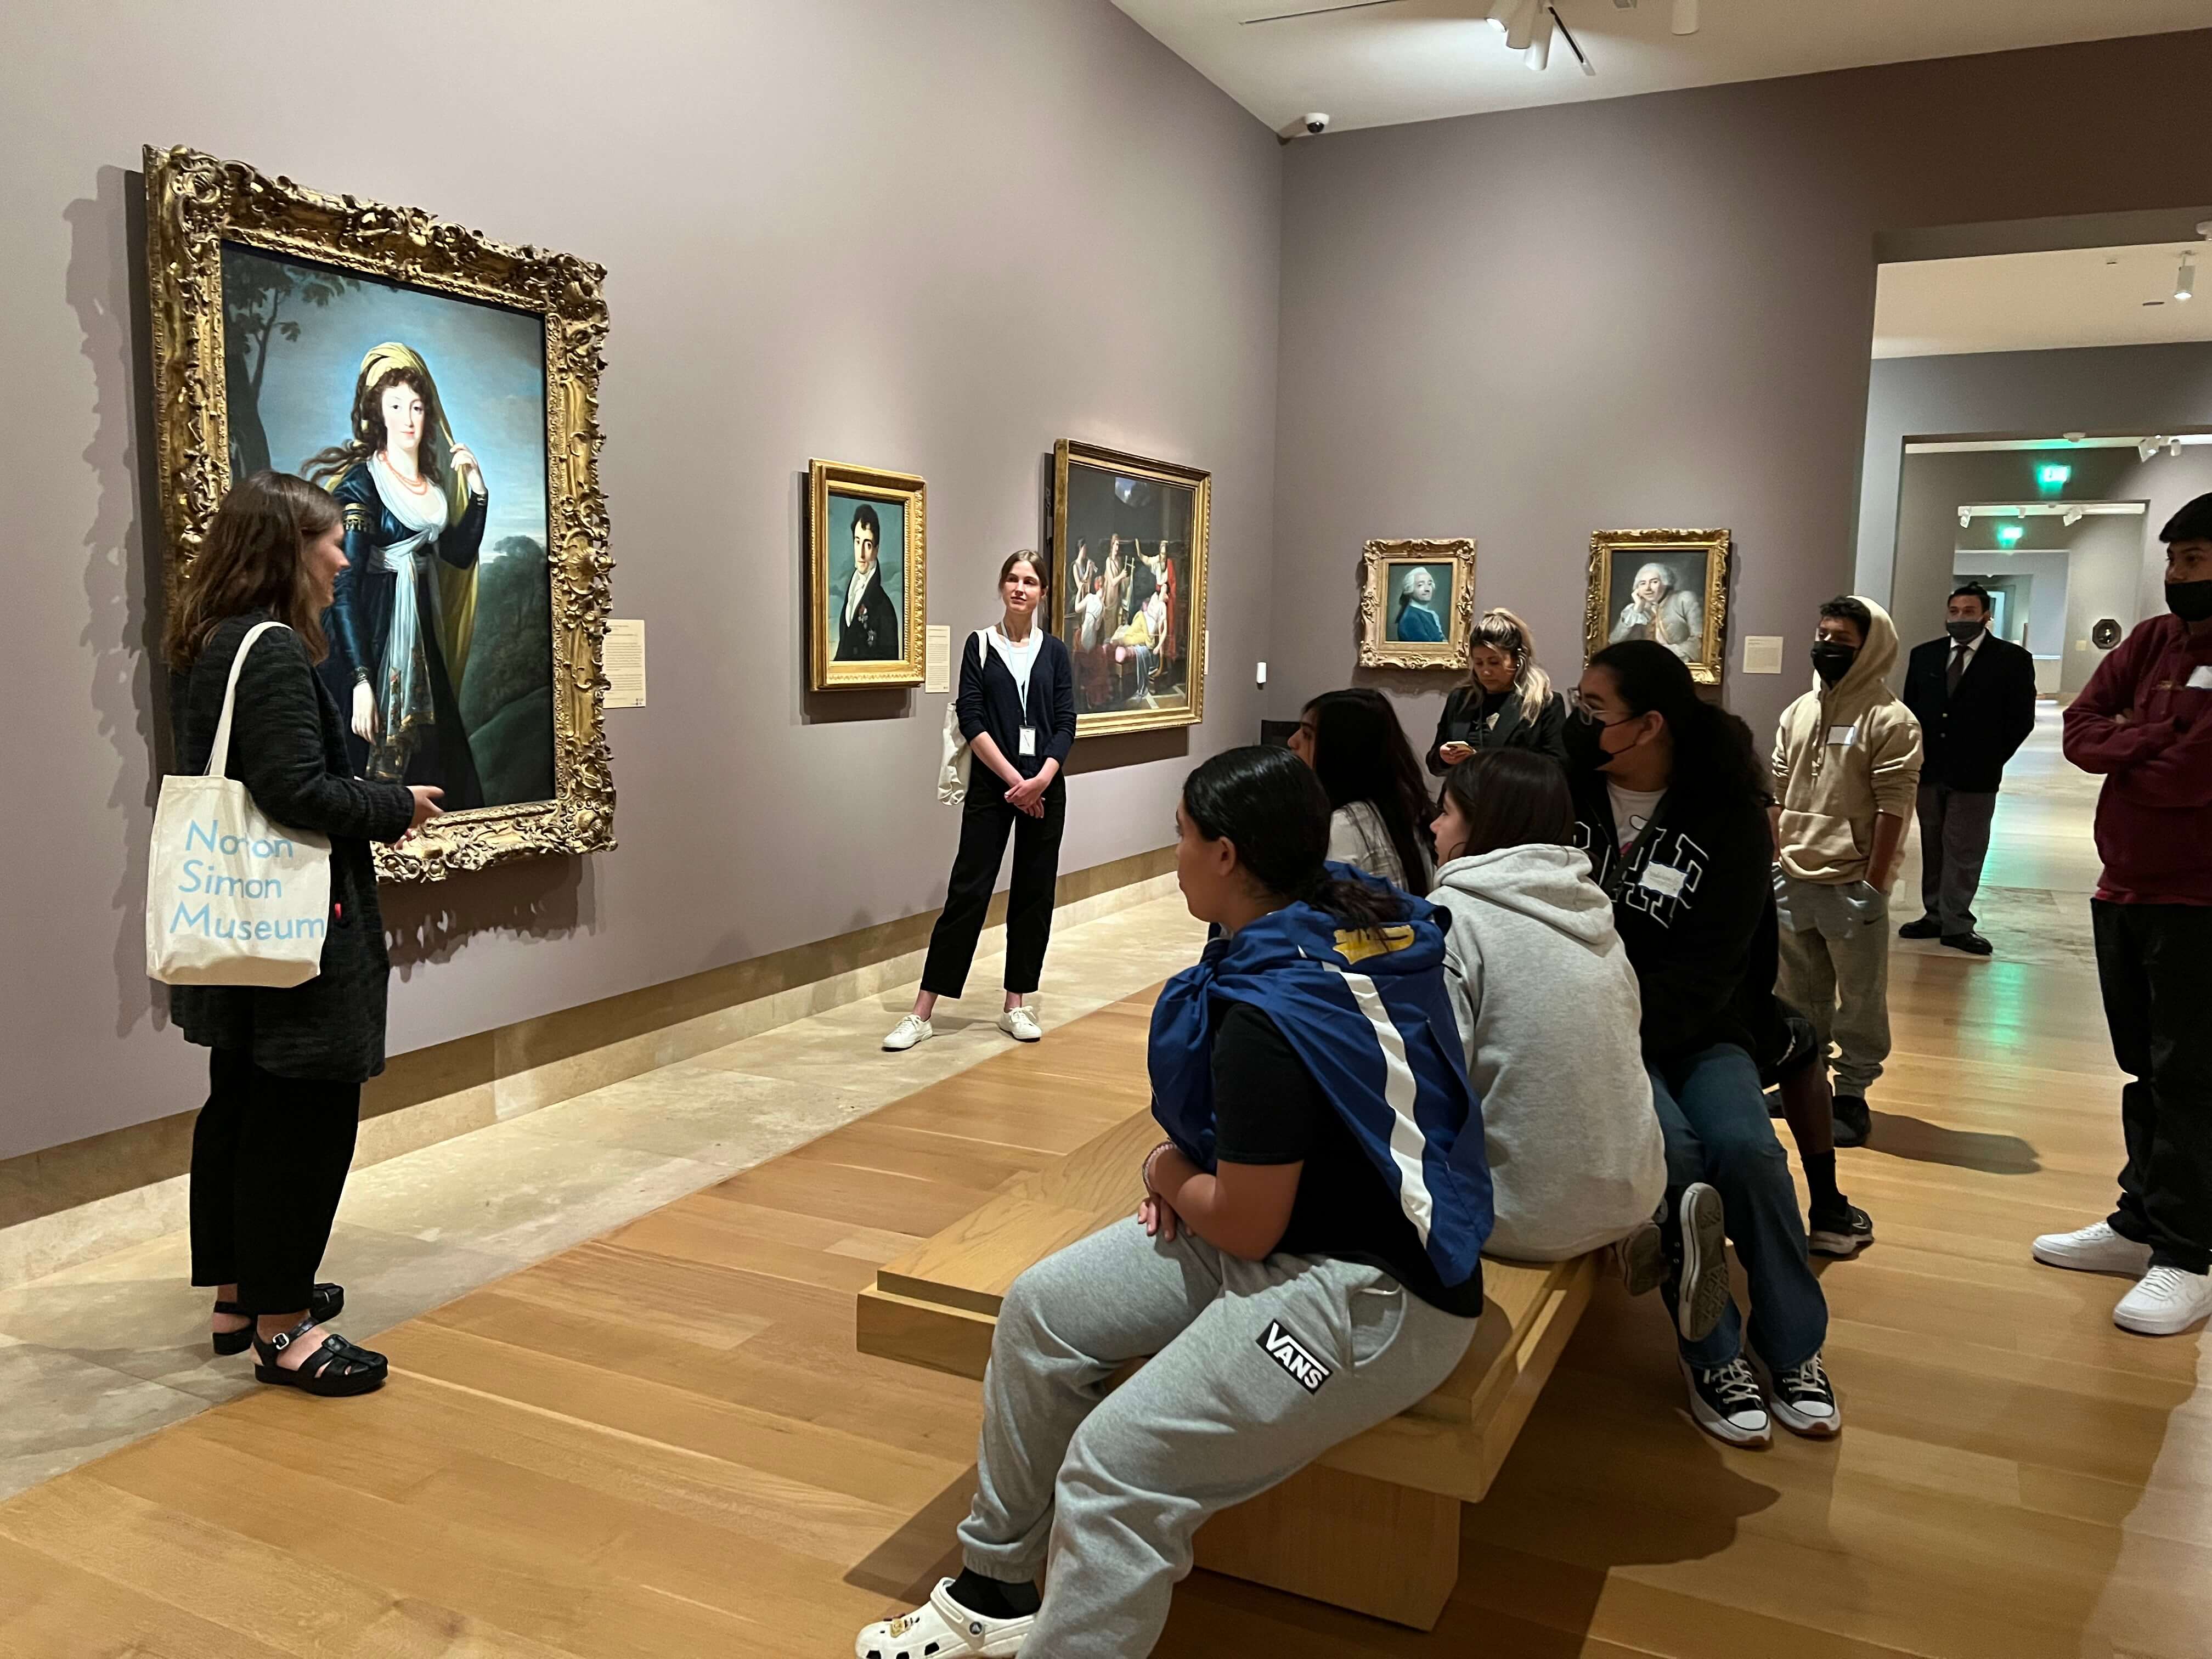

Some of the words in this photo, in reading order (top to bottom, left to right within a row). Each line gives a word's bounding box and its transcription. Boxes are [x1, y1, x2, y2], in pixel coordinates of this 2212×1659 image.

[185, 819, 294, 858] Noon
[178, 860, 281, 899] Simon
[170, 901, 325, 941] Museum
[1266, 1322, 1330, 1389] VANS
